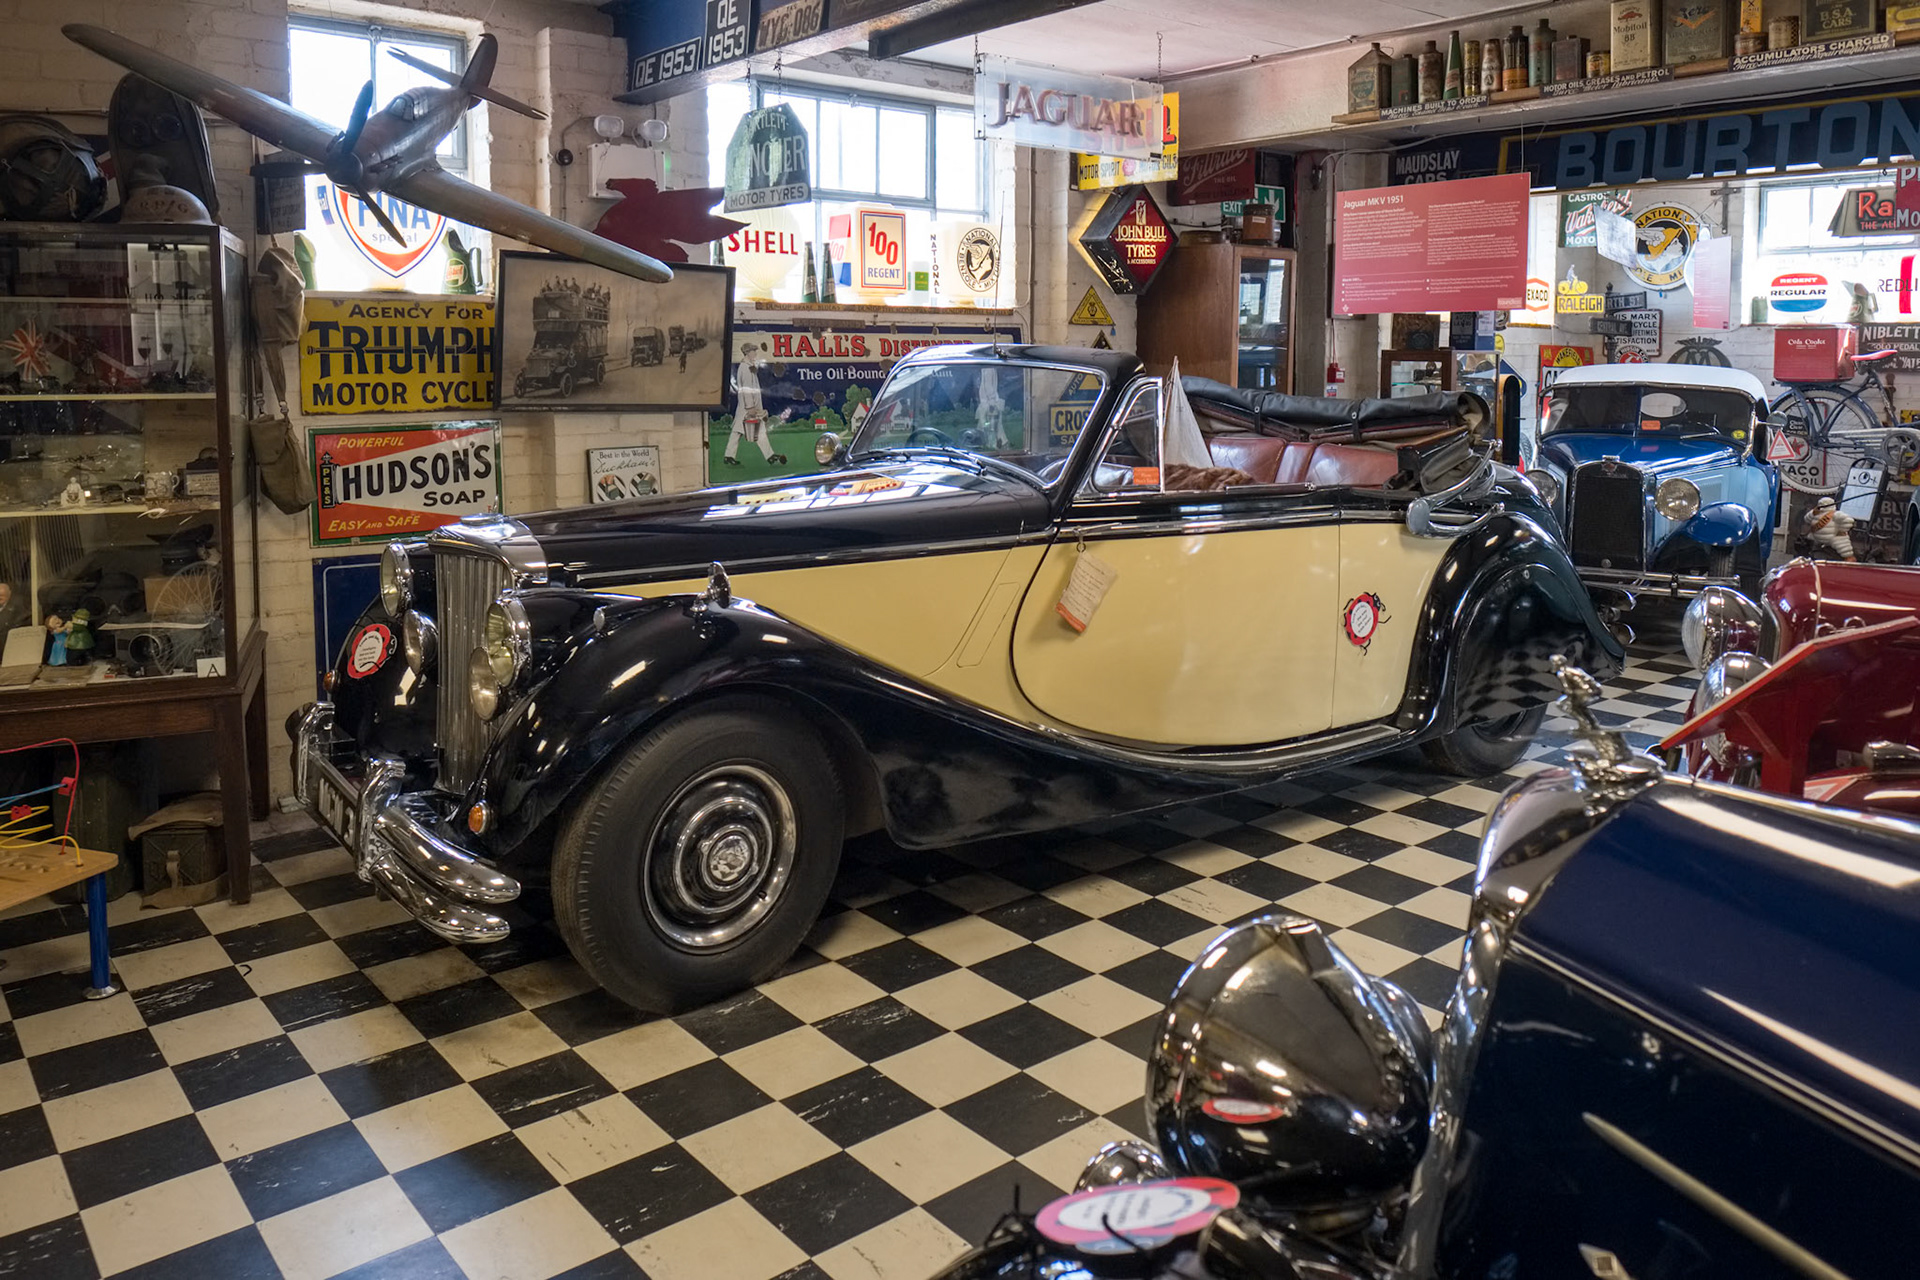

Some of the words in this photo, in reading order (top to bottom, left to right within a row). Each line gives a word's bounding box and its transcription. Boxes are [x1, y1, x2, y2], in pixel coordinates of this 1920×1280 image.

[717, 0, 739, 30] QE
[1819, 8, 1857, 22] B.S.A.
[1822, 17, 1852, 29] CARS
[1613, 22, 1647, 34] Mobiloil
[707, 25, 746, 65] 1953
[1733, 43, 1826, 65] ACCUMULATORS
[1829, 34, 1890, 51] CHARGED
[635, 57, 656, 88] QE
[658, 43, 697, 80] 1953
[1543, 82, 1567, 93] MOTOR
[1585, 75, 1620, 86] GREASES
[1621, 75, 1635, 83] AND
[1636, 69, 1670, 80] PETROL
[986, 83, 1144, 138] JAGUAR
[1381, 104, 1423, 116] MACHINES
[1424, 101, 1446, 110] BUILT
[1459, 95, 1487, 105] ORDER
[1557, 98, 1920, 190] BOURTON
[1079, 163, 1099, 181] MOTOR
[1101, 161, 1120, 178] SPIRIT
[1396, 150, 1460, 175] MAUDSLAY
[730, 191, 765, 208] MOTOR
[770, 186, 805, 202] TYRES
[1343, 200, 1367, 210] Jaguar
[1367, 197, 1380, 206] MK
[1387, 195, 1404, 204] 1951
[1222, 201, 1243, 214] EXIT
[1117, 225, 1143, 239] JOHN
[1144, 226, 1166, 239] BULL
[1861, 221, 1877, 230] THE
[728, 229, 799, 256] SHELL
[868, 221, 898, 266] 100
[965, 230, 997, 248] NATIONAL
[1566, 236, 1596, 245] MOTO
[1126, 244, 1157, 257] TYRES
[930, 234, 940, 294] NATIONAL
[867, 267, 901, 280] REGENT
[1877, 278, 1919, 292] REDLI
[1527, 289, 1548, 301] EXACO
[1559, 297, 1603, 311] RALEIGH
[348, 304, 433, 320] AGENCY
[446, 305, 483, 320] FOR
[307, 320, 495, 379] TRIUMPH
[772, 334, 867, 358] HALL'S
[1556, 348, 1581, 365] WAKEFIELD
[797, 368, 822, 381] The
[1068, 372, 1084, 396] AUTO
[312, 381, 408, 406] MOTOR
[337, 436, 405, 449] POWERFUL
[599, 451, 613, 459] Best
[632, 449, 650, 457] World
[341, 441, 492, 501] HUDSON'S
[593, 457, 656, 474] Duckham's
[423, 489, 486, 507] SOAP
[328, 519, 367, 532] EASY
[366, 521, 383, 529] AND
[385, 514, 420, 528] SAFE
[207, 664, 221, 678] A
